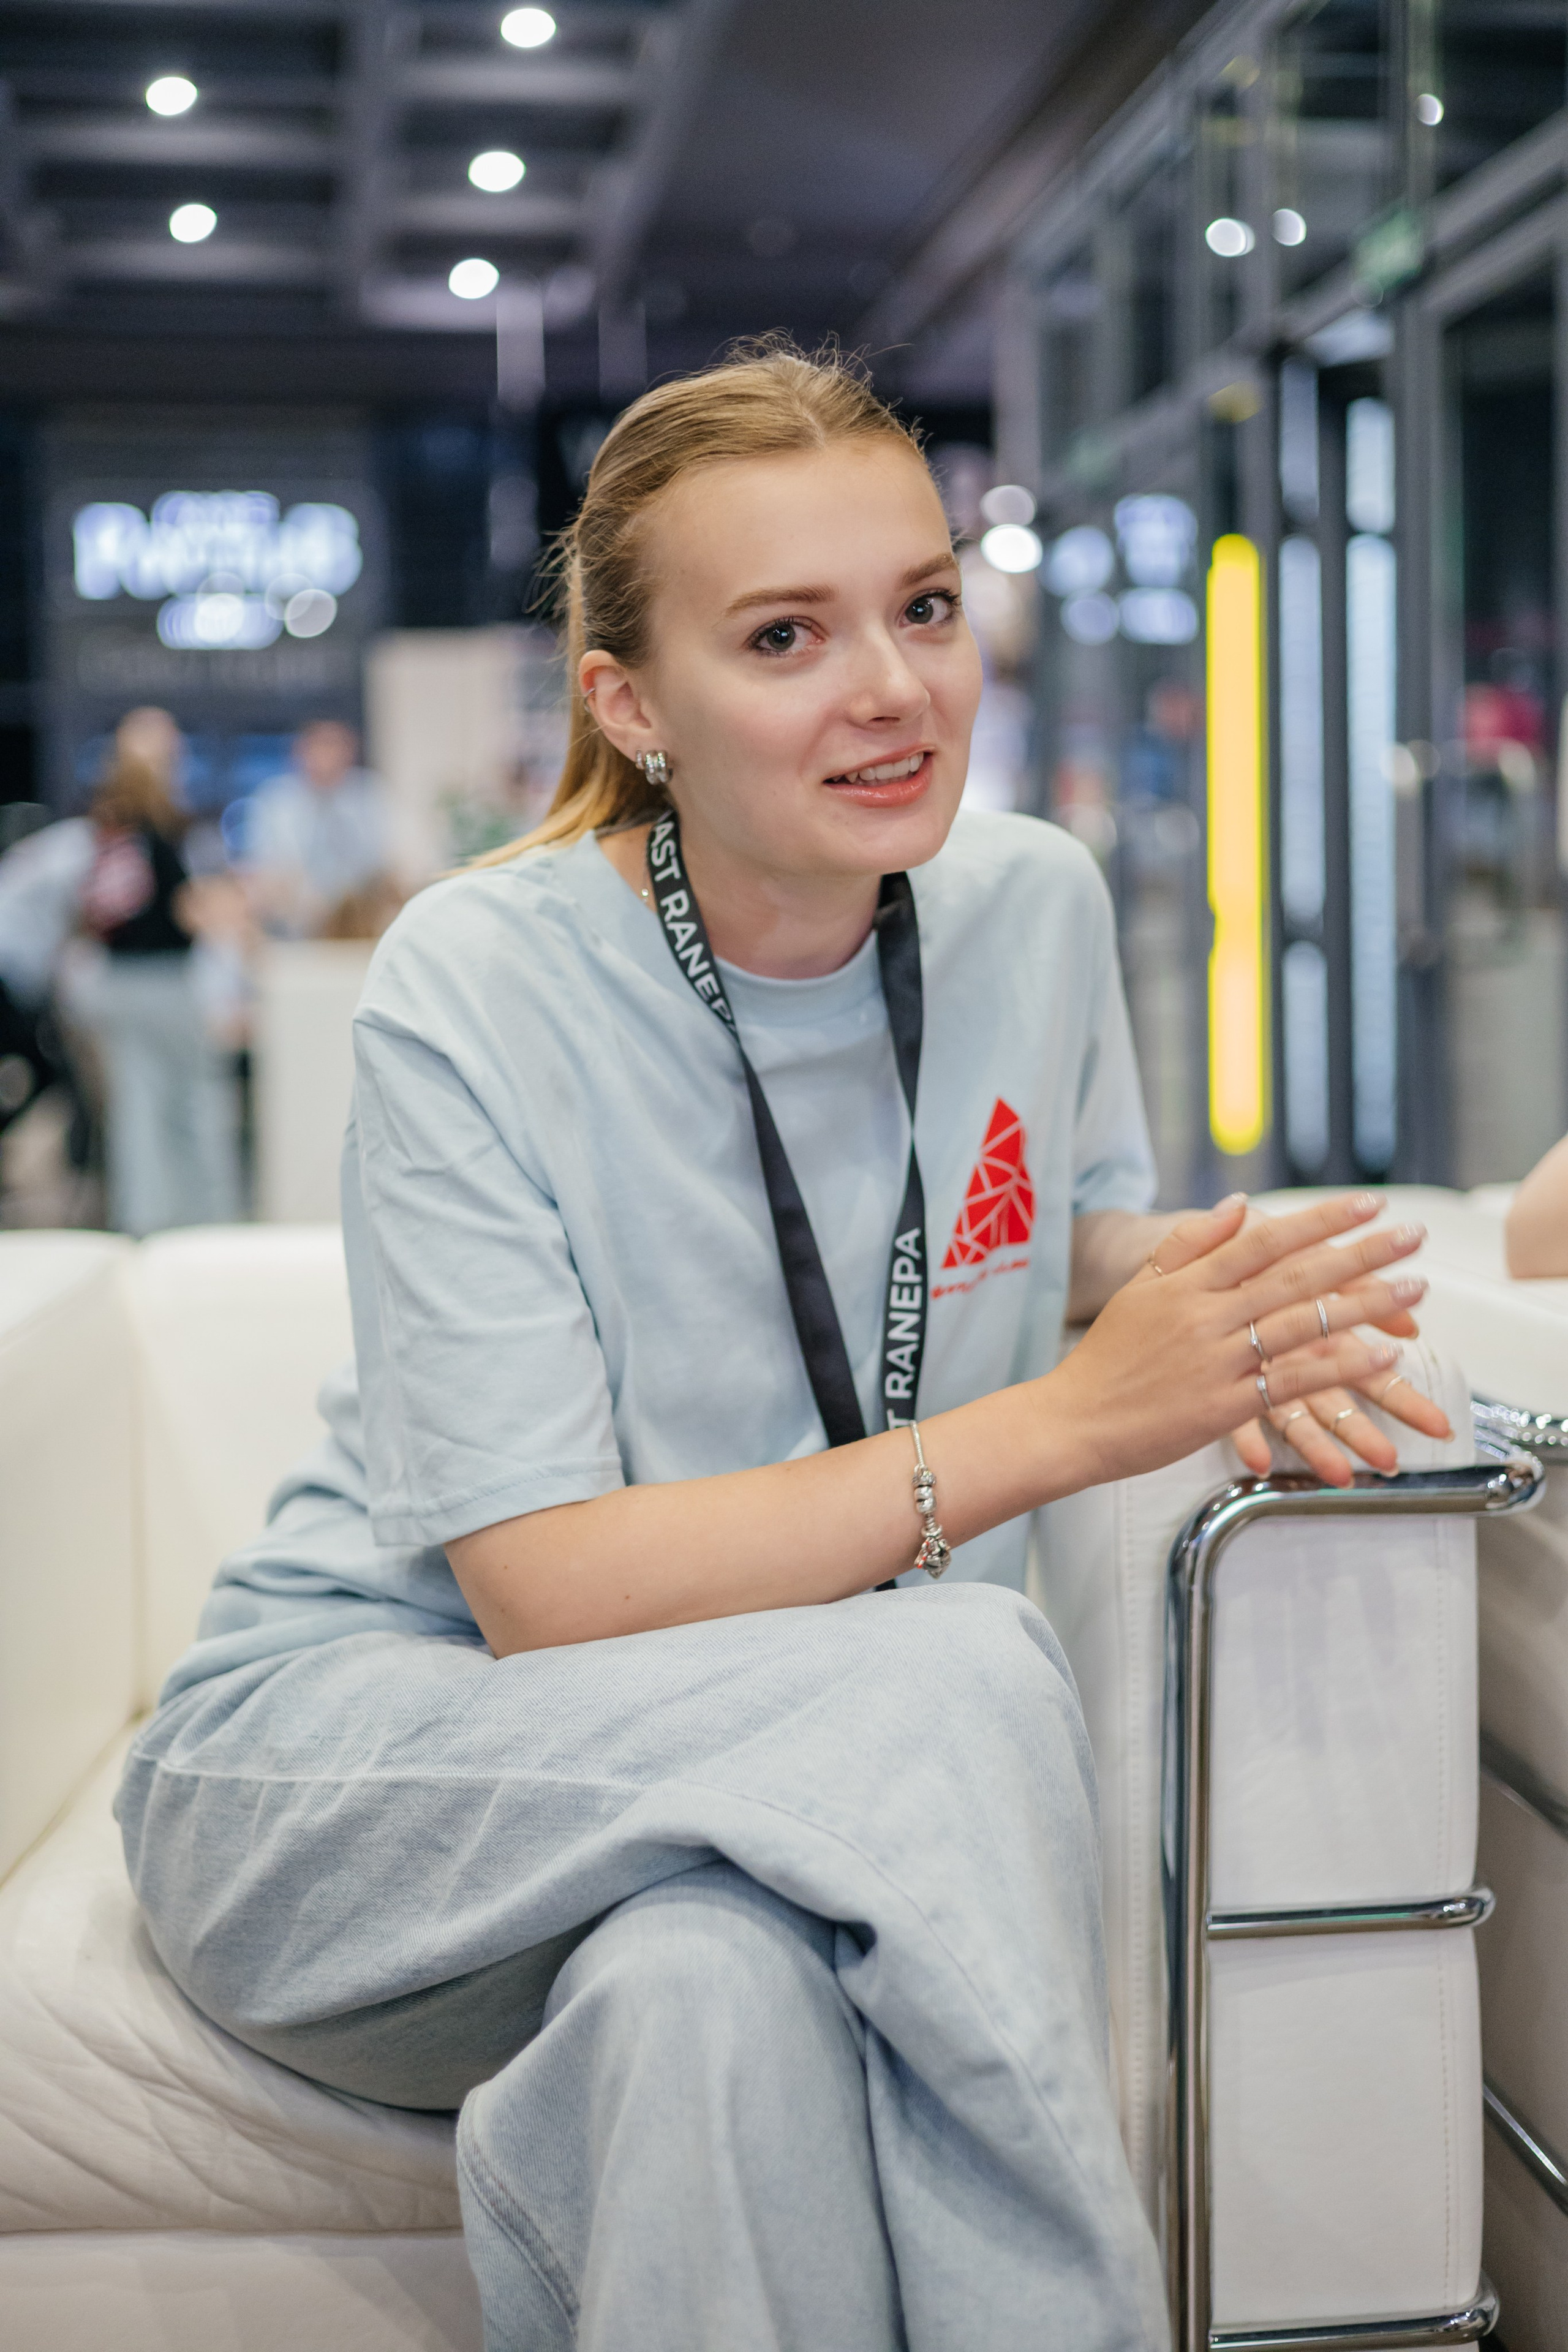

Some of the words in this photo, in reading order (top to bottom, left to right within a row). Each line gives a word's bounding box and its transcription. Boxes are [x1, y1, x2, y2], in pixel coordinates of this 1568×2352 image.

[651, 809, 680, 881] AST
[660, 889, 735, 1023] RANEP
[884, 1227, 922, 1399] RANEPA
